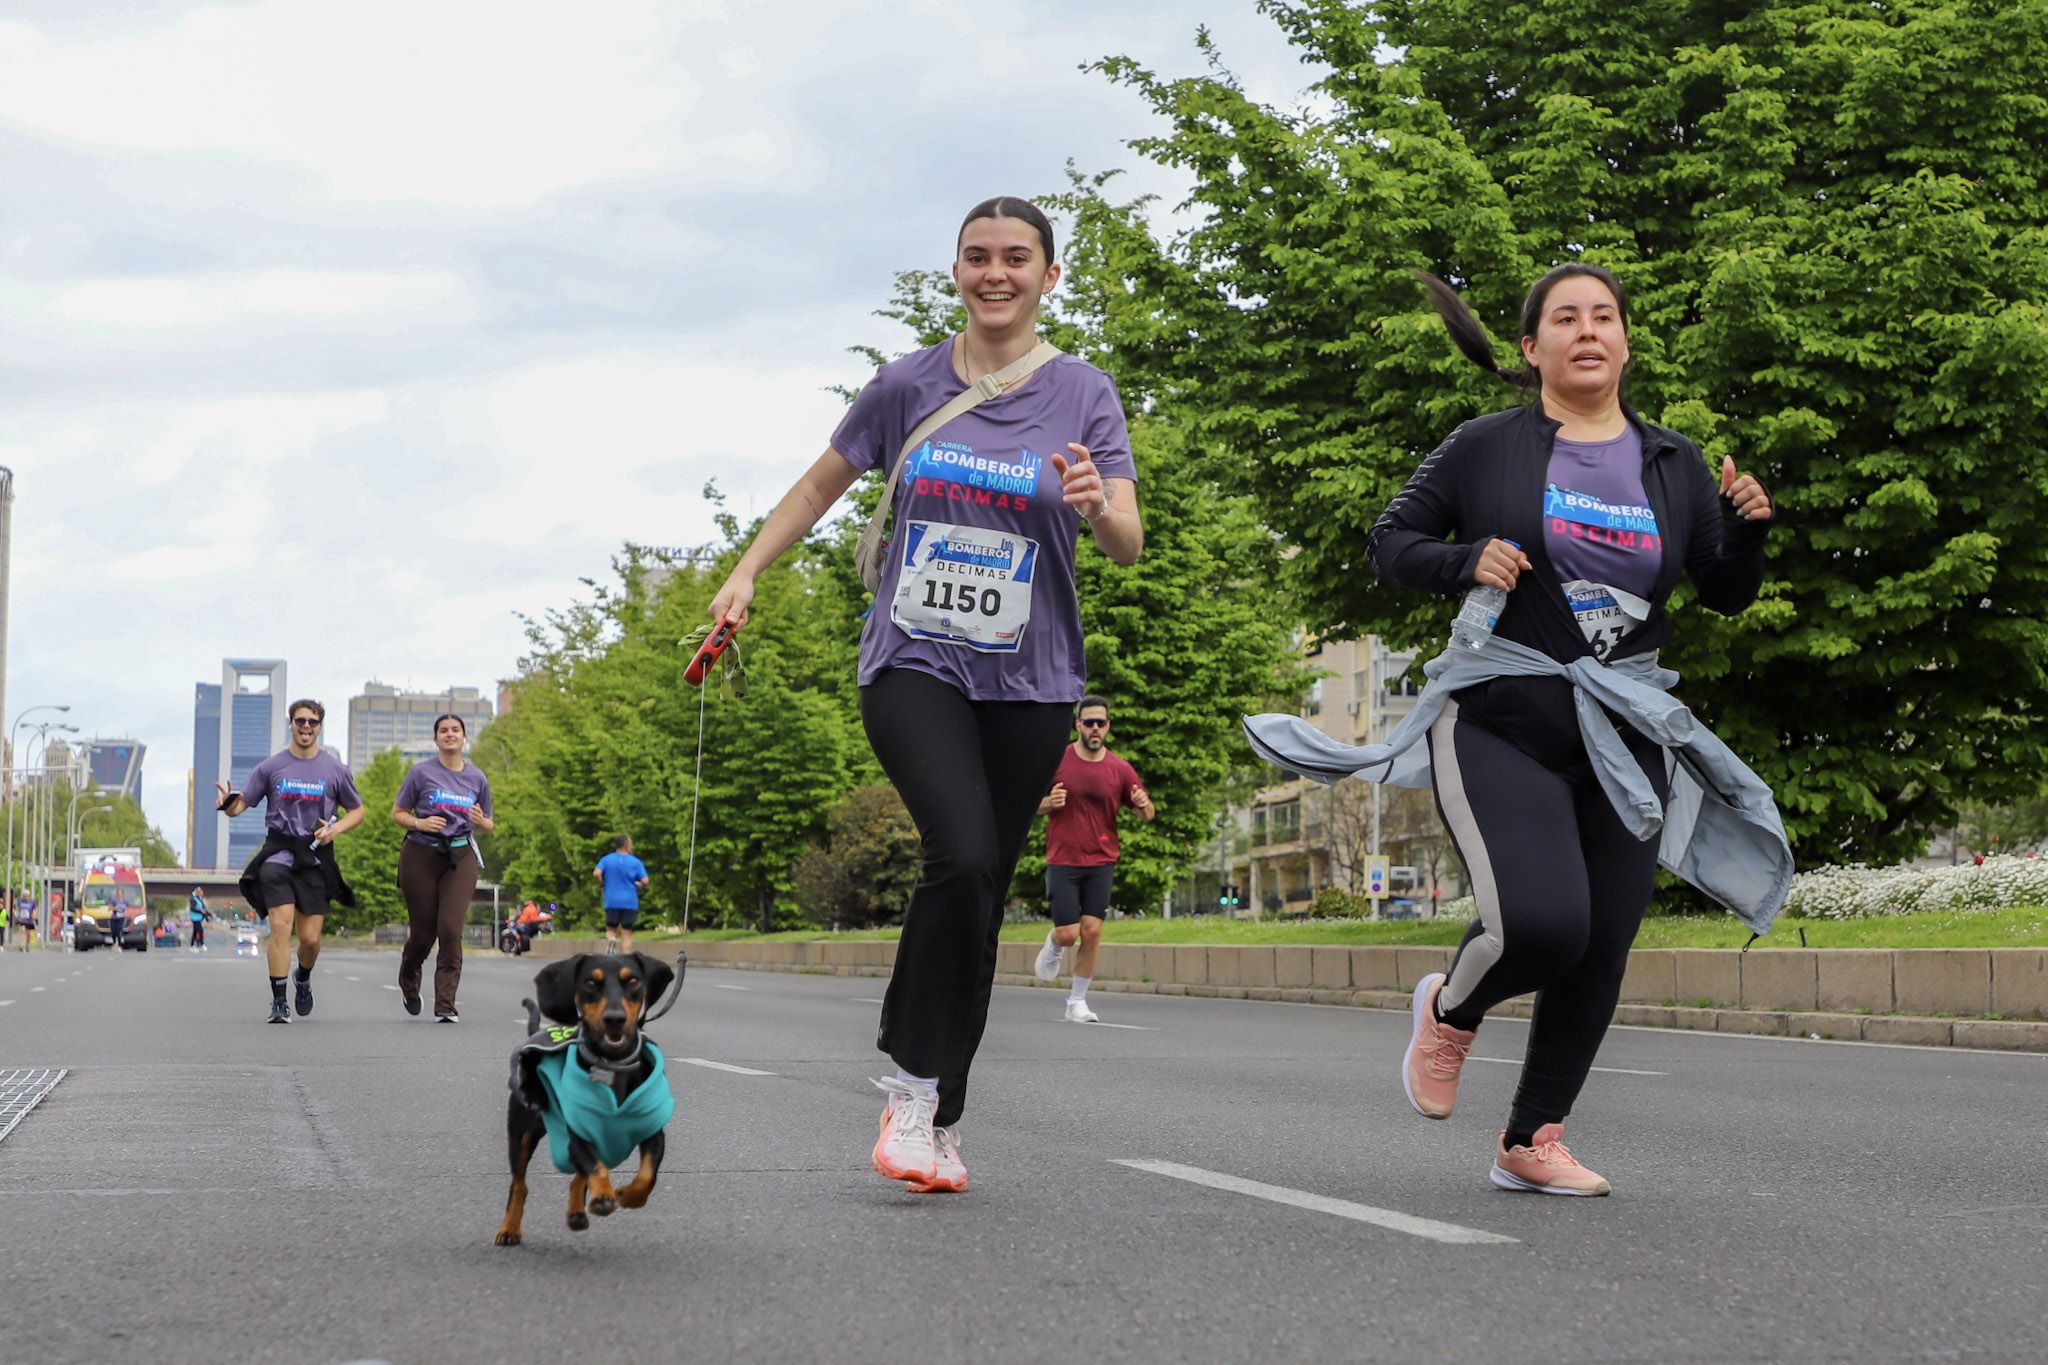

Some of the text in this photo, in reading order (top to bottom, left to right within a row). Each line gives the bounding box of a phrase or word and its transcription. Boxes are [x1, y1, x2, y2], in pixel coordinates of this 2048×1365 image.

[936, 440, 973, 453] CARRERA
[932, 449, 1035, 480] BOMBEROS
[968, 470, 1034, 495] de MADRID
[916, 476, 1028, 512] DECIMAS
[1607, 514, 1622, 528] de
[1551, 518, 1663, 552] DECIMA
[947, 542, 1011, 560] BOMBEROS
[936, 561, 1007, 580] DECIMAS
[970, 556, 1010, 568] de MADRID
[922, 579, 1002, 617] 1150
[1577, 607, 1628, 622] ECIMA
[288, 781, 324, 791] BOMBEROS
